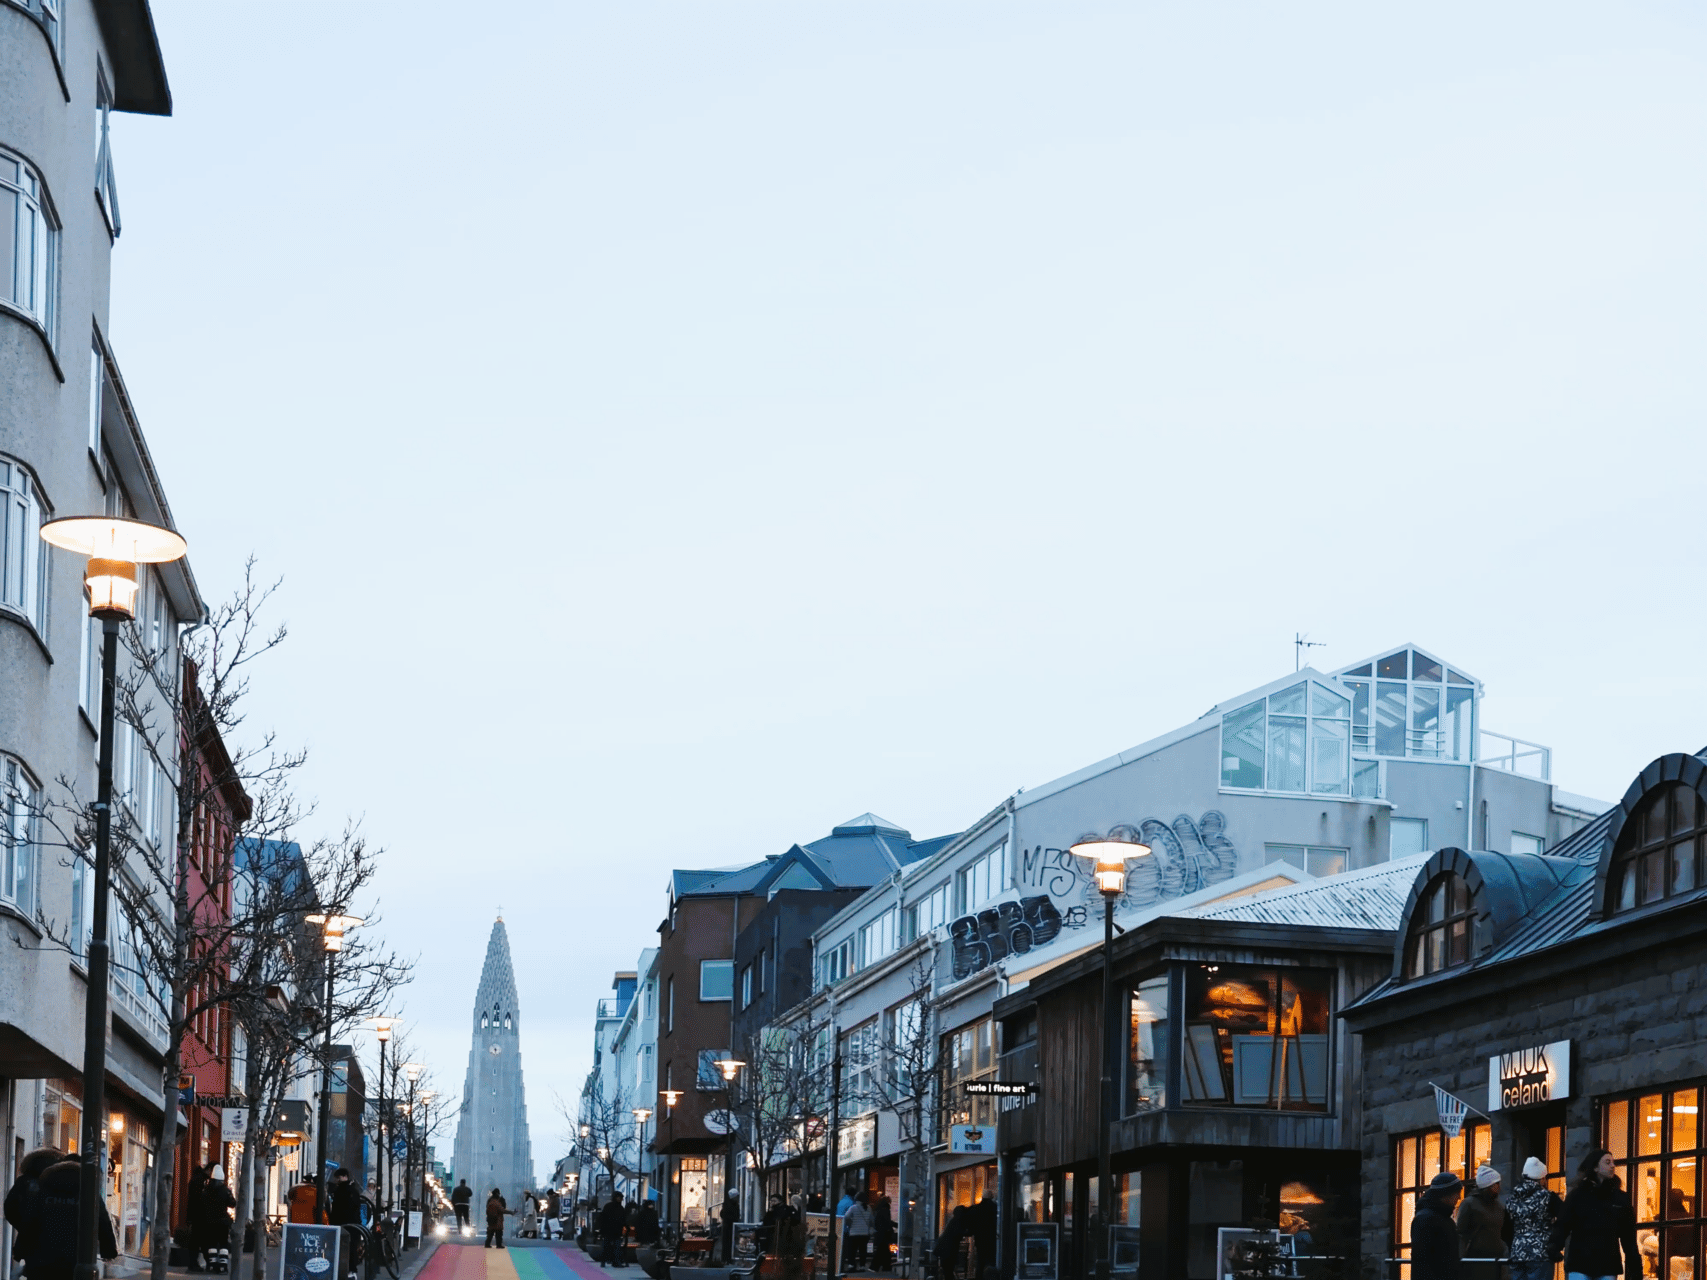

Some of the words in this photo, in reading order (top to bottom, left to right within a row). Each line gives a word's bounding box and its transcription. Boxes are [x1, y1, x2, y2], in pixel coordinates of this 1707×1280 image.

[1023, 845, 1076, 897] MFS
[993, 1083, 1011, 1093] fine
[1012, 1084, 1026, 1093] art
[1499, 1072, 1549, 1109] Iceland
